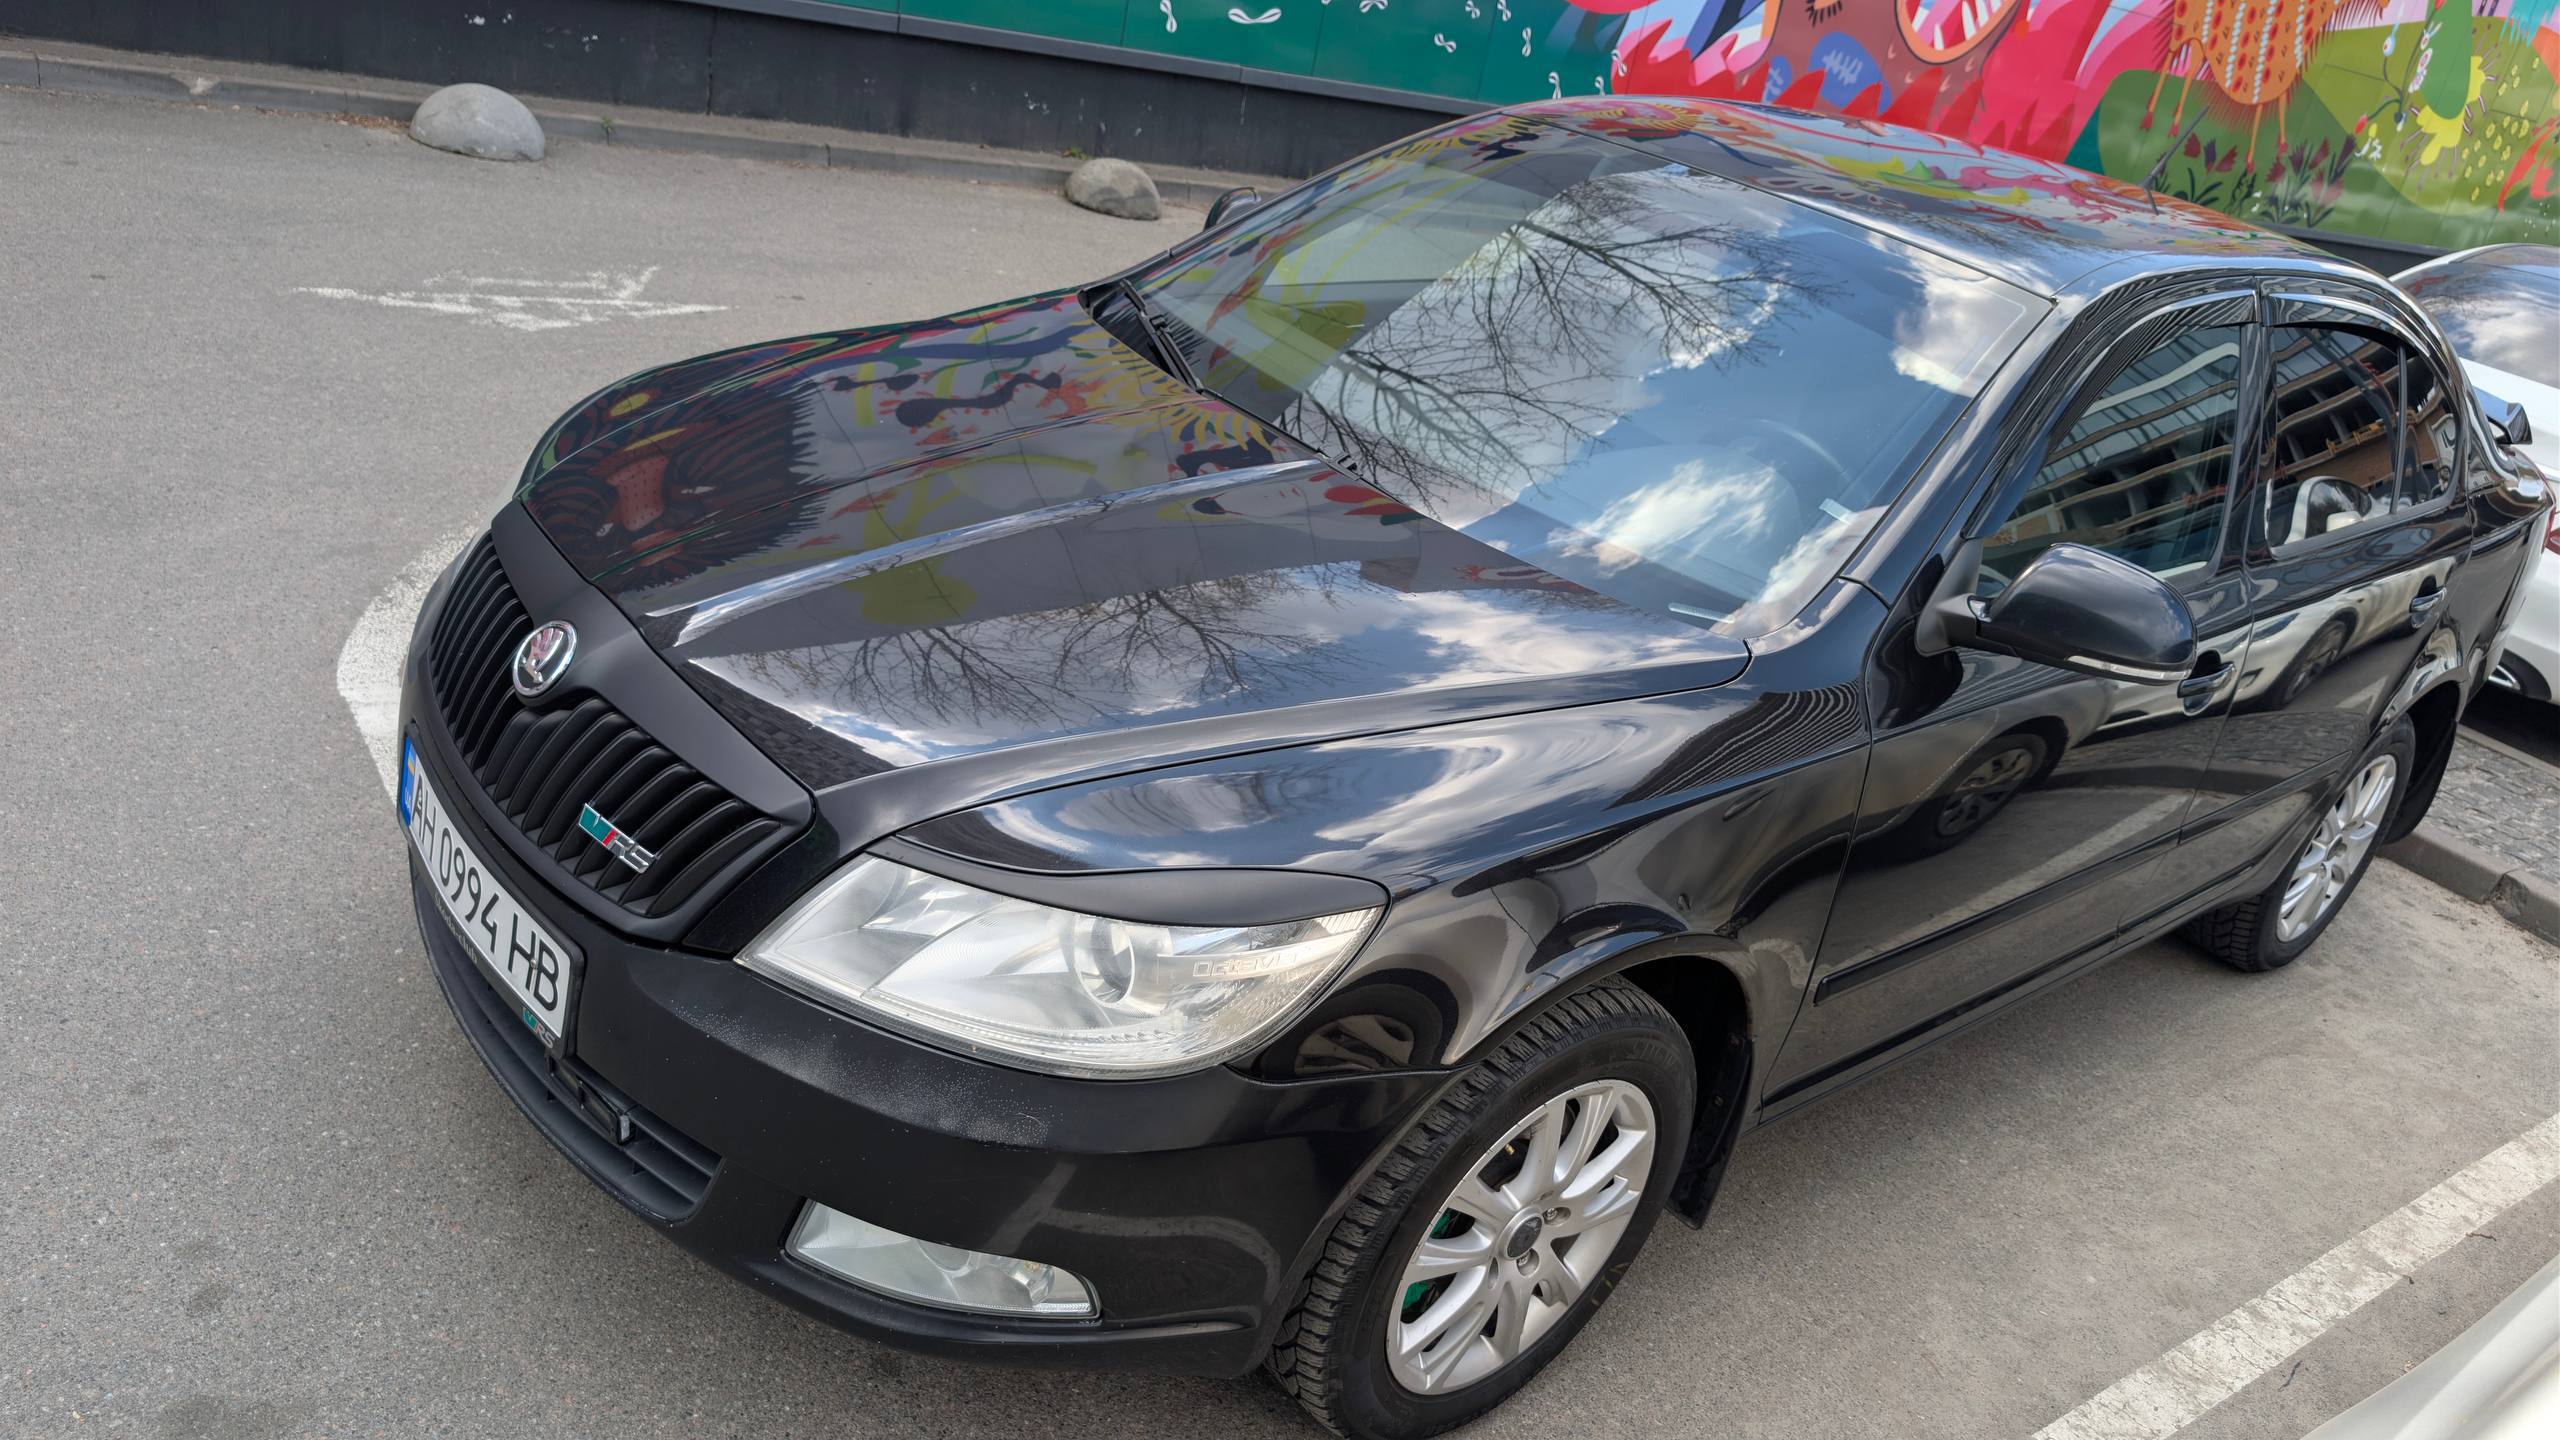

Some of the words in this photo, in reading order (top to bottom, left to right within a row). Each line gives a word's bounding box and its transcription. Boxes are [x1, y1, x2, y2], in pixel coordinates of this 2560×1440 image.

[411, 773, 436, 862] AH
[439, 828, 500, 955] 0994
[508, 912, 559, 1011] HB
